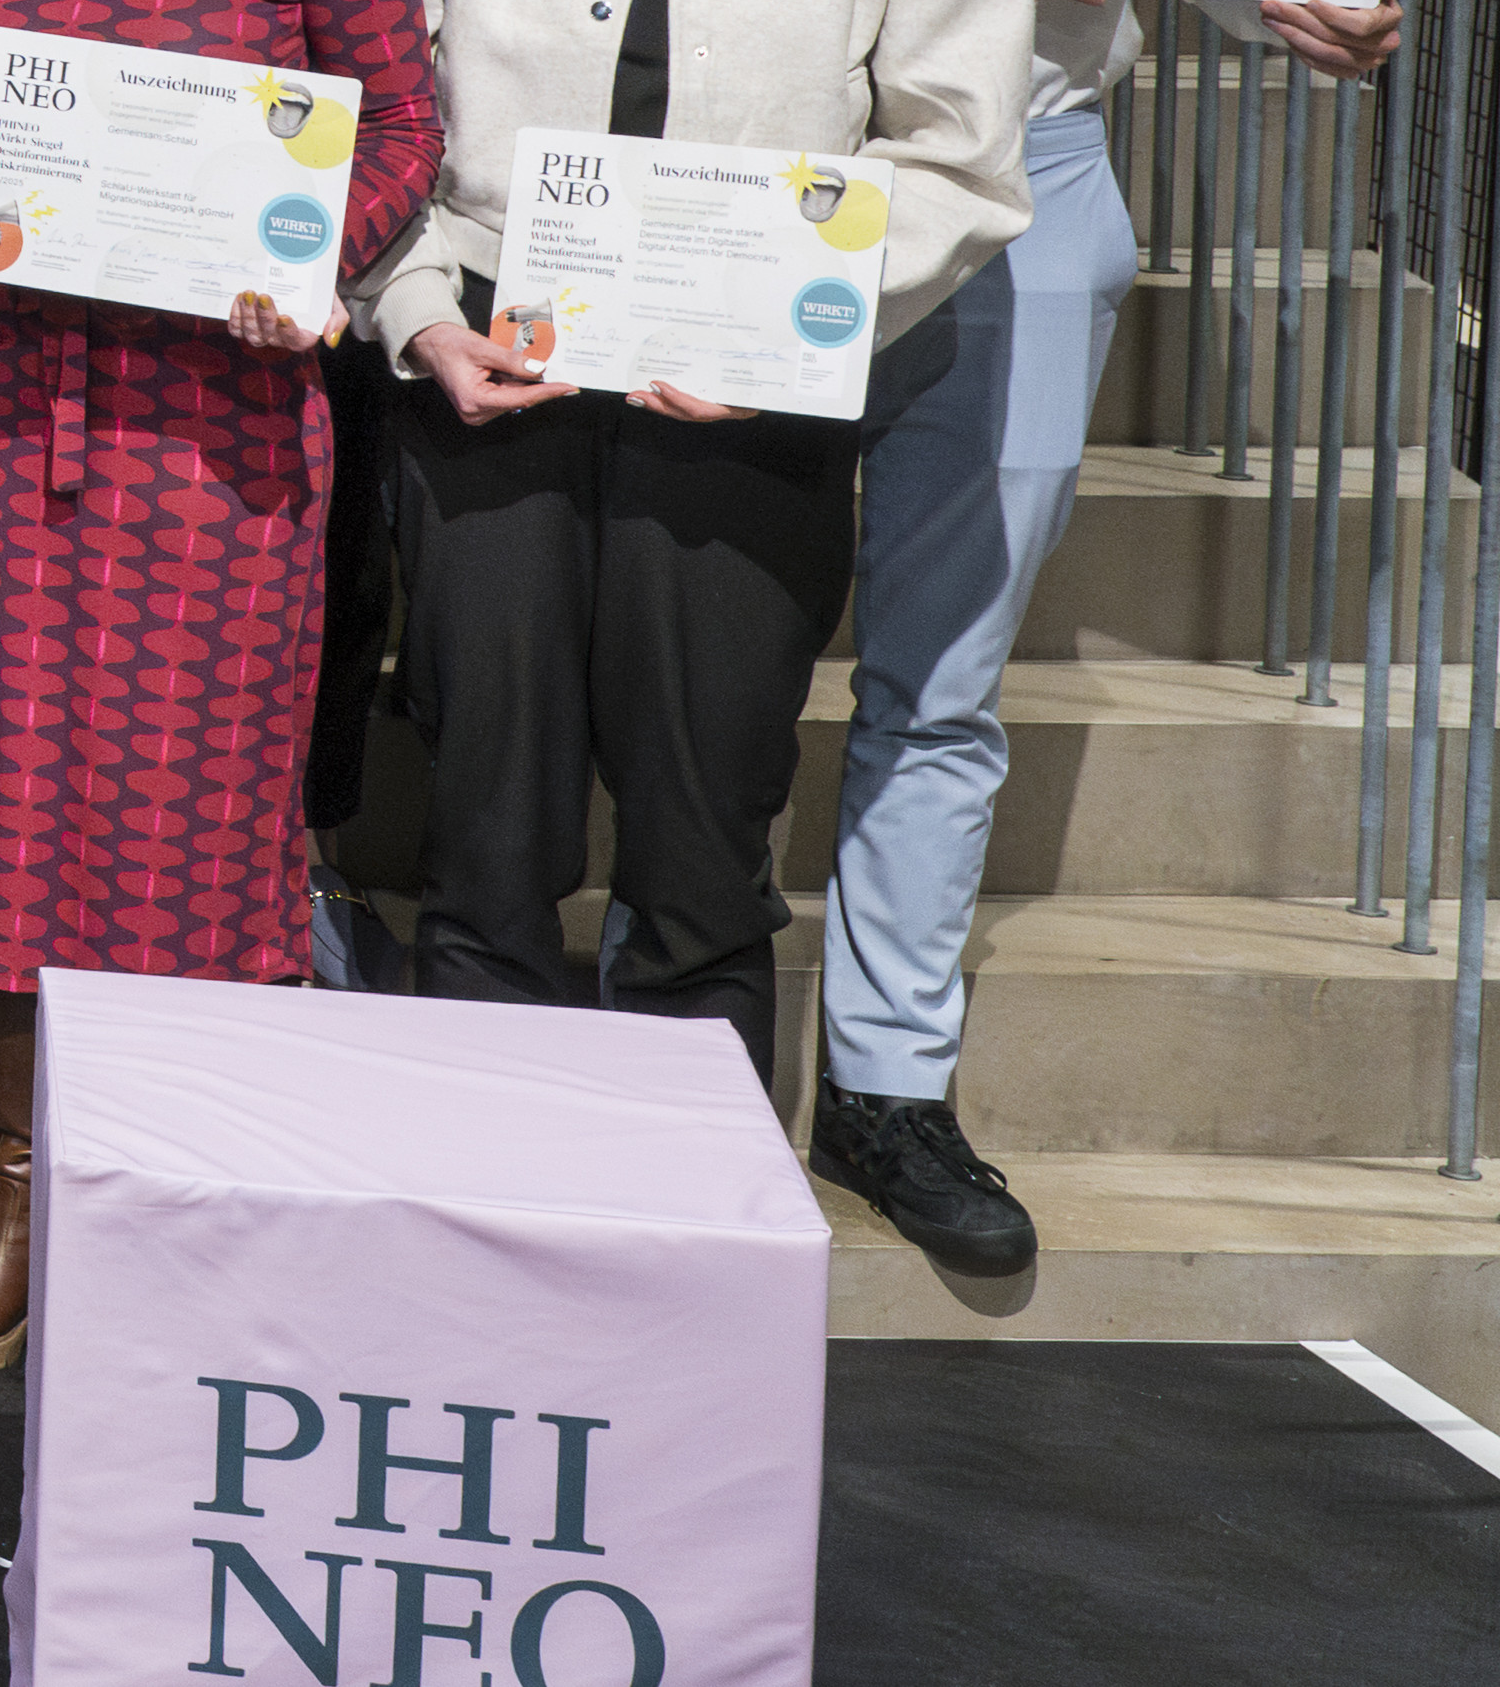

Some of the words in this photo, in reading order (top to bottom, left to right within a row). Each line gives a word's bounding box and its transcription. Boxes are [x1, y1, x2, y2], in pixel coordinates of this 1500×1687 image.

[5, 53, 69, 84] PHI
[2, 79, 75, 110] NEO
[116, 69, 236, 101] Auszeichnung
[540, 152, 603, 180] PHI
[650, 162, 769, 188] Auszeichnung
[536, 178, 609, 206] NEO
[270, 216, 322, 236] WIRKT!
[803, 301, 855, 320] WIRKT!
[193, 1376, 611, 1556] PHI
[188, 1537, 666, 1687] NEO
